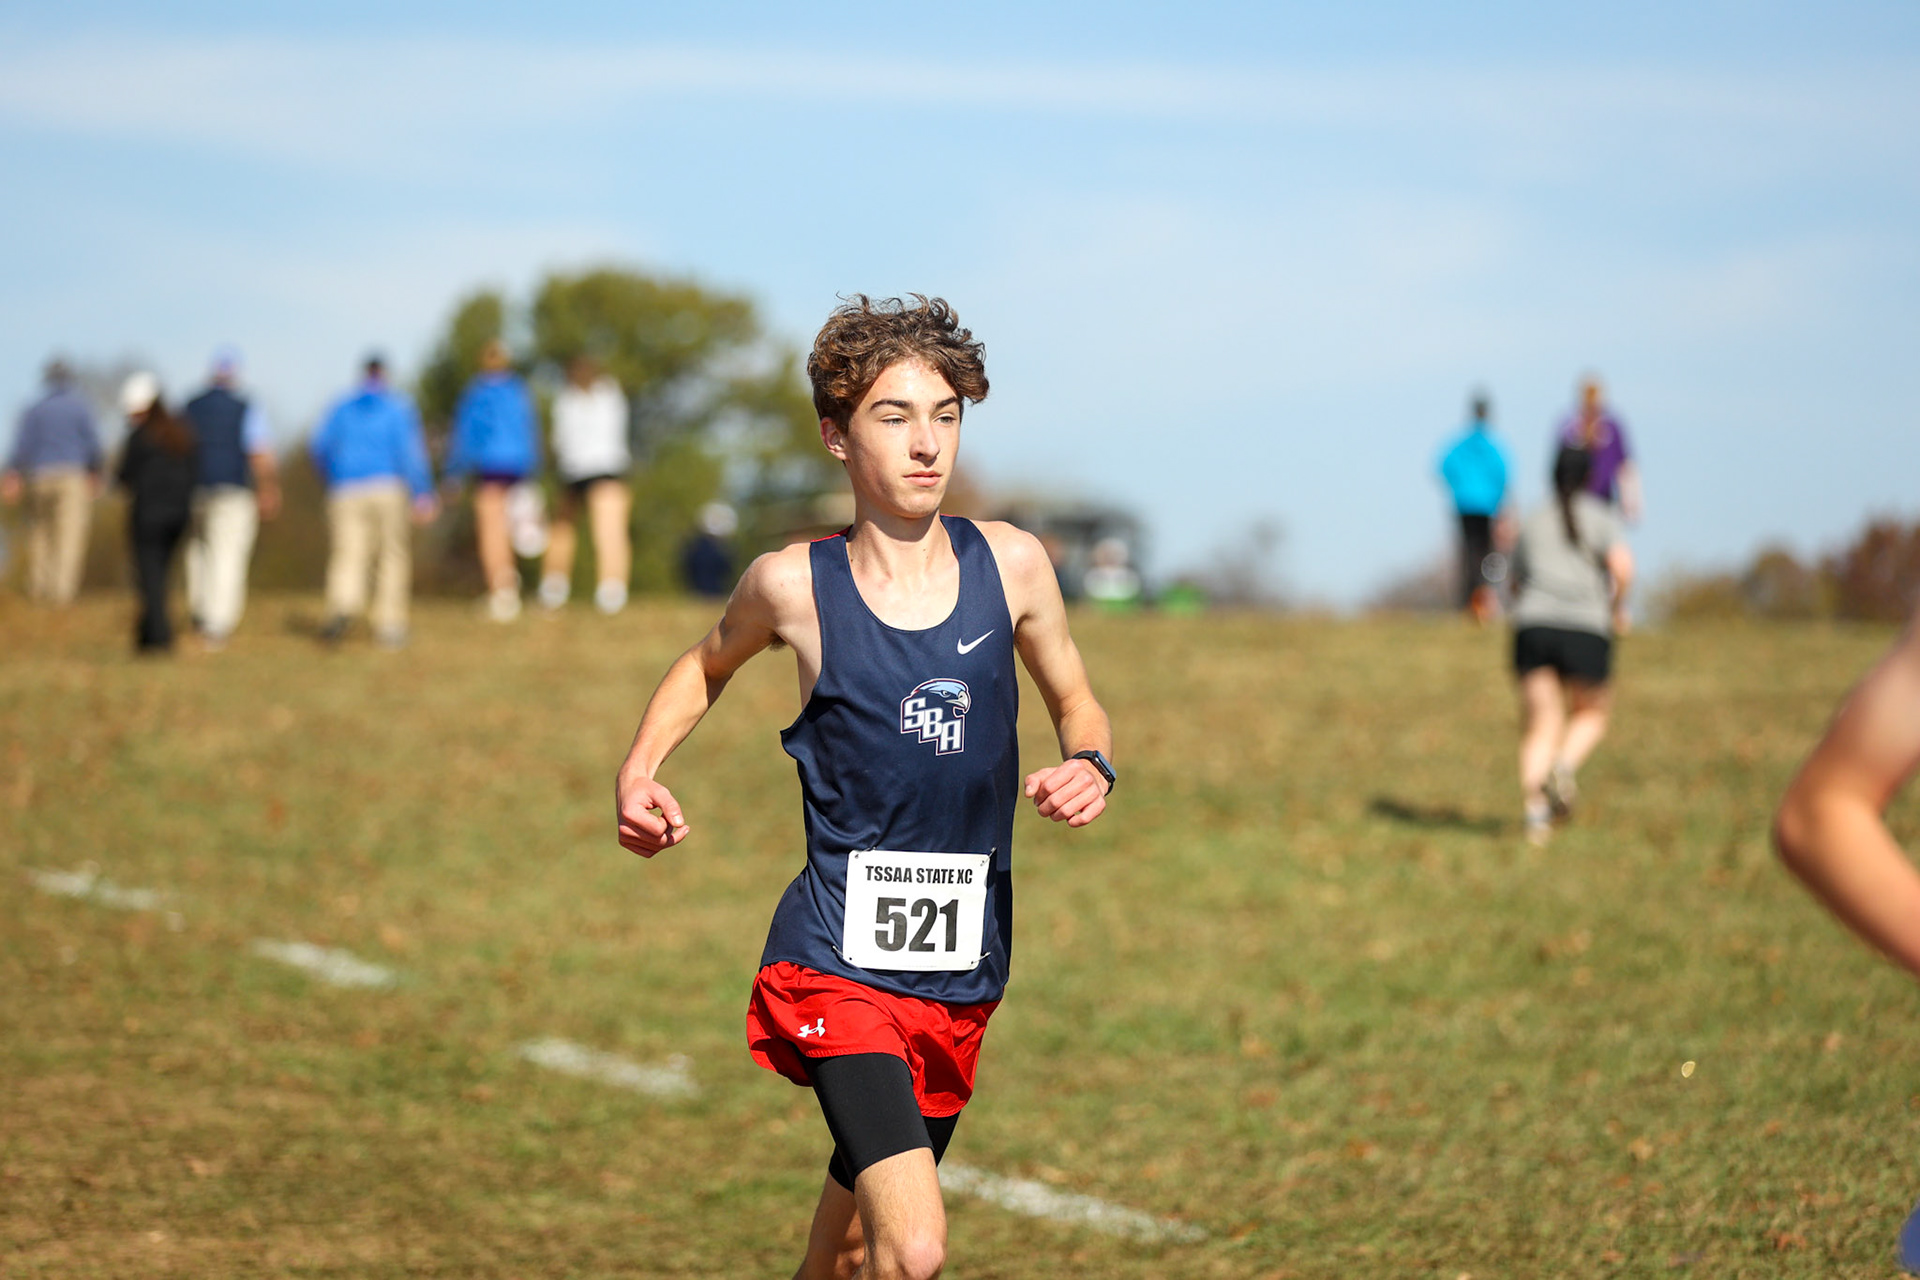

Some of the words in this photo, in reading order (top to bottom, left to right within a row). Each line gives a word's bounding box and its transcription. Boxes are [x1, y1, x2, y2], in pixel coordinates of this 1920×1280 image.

[904, 697, 962, 752] SBA
[865, 865, 912, 883] TSSAA
[916, 868, 955, 884] STATE
[956, 868, 973, 884] XC
[875, 897, 959, 952] 521
